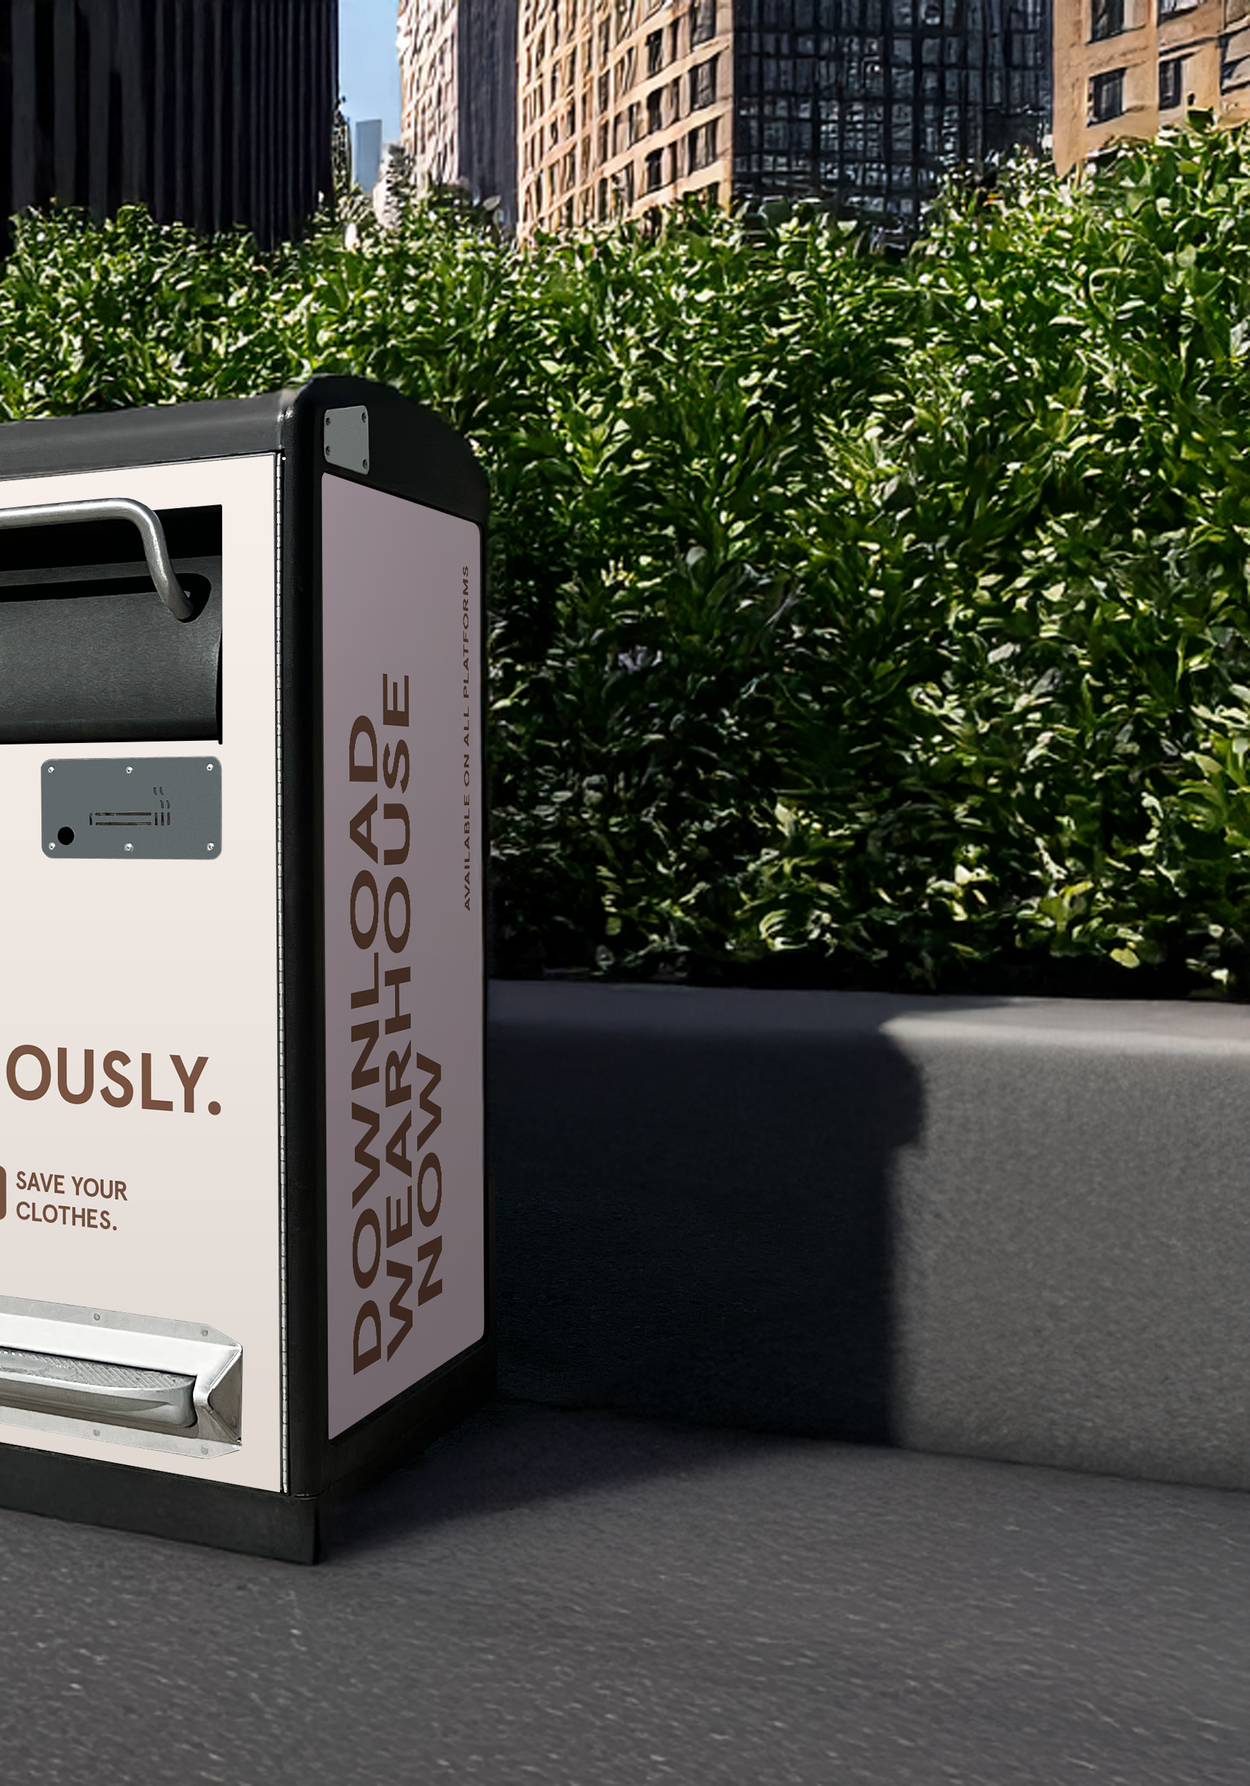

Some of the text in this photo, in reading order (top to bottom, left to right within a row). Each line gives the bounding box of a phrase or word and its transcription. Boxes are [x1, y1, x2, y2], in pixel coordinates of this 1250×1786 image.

[463, 754, 470, 787] ON
[349, 715, 381, 1375] DOWNLOAD
[382, 673, 413, 1363] WEARHOUSE
[15, 1170, 128, 1201] SAVE YOUR
[15, 1202, 118, 1231] CLOTHES.
[416, 1053, 443, 1307] NOW
